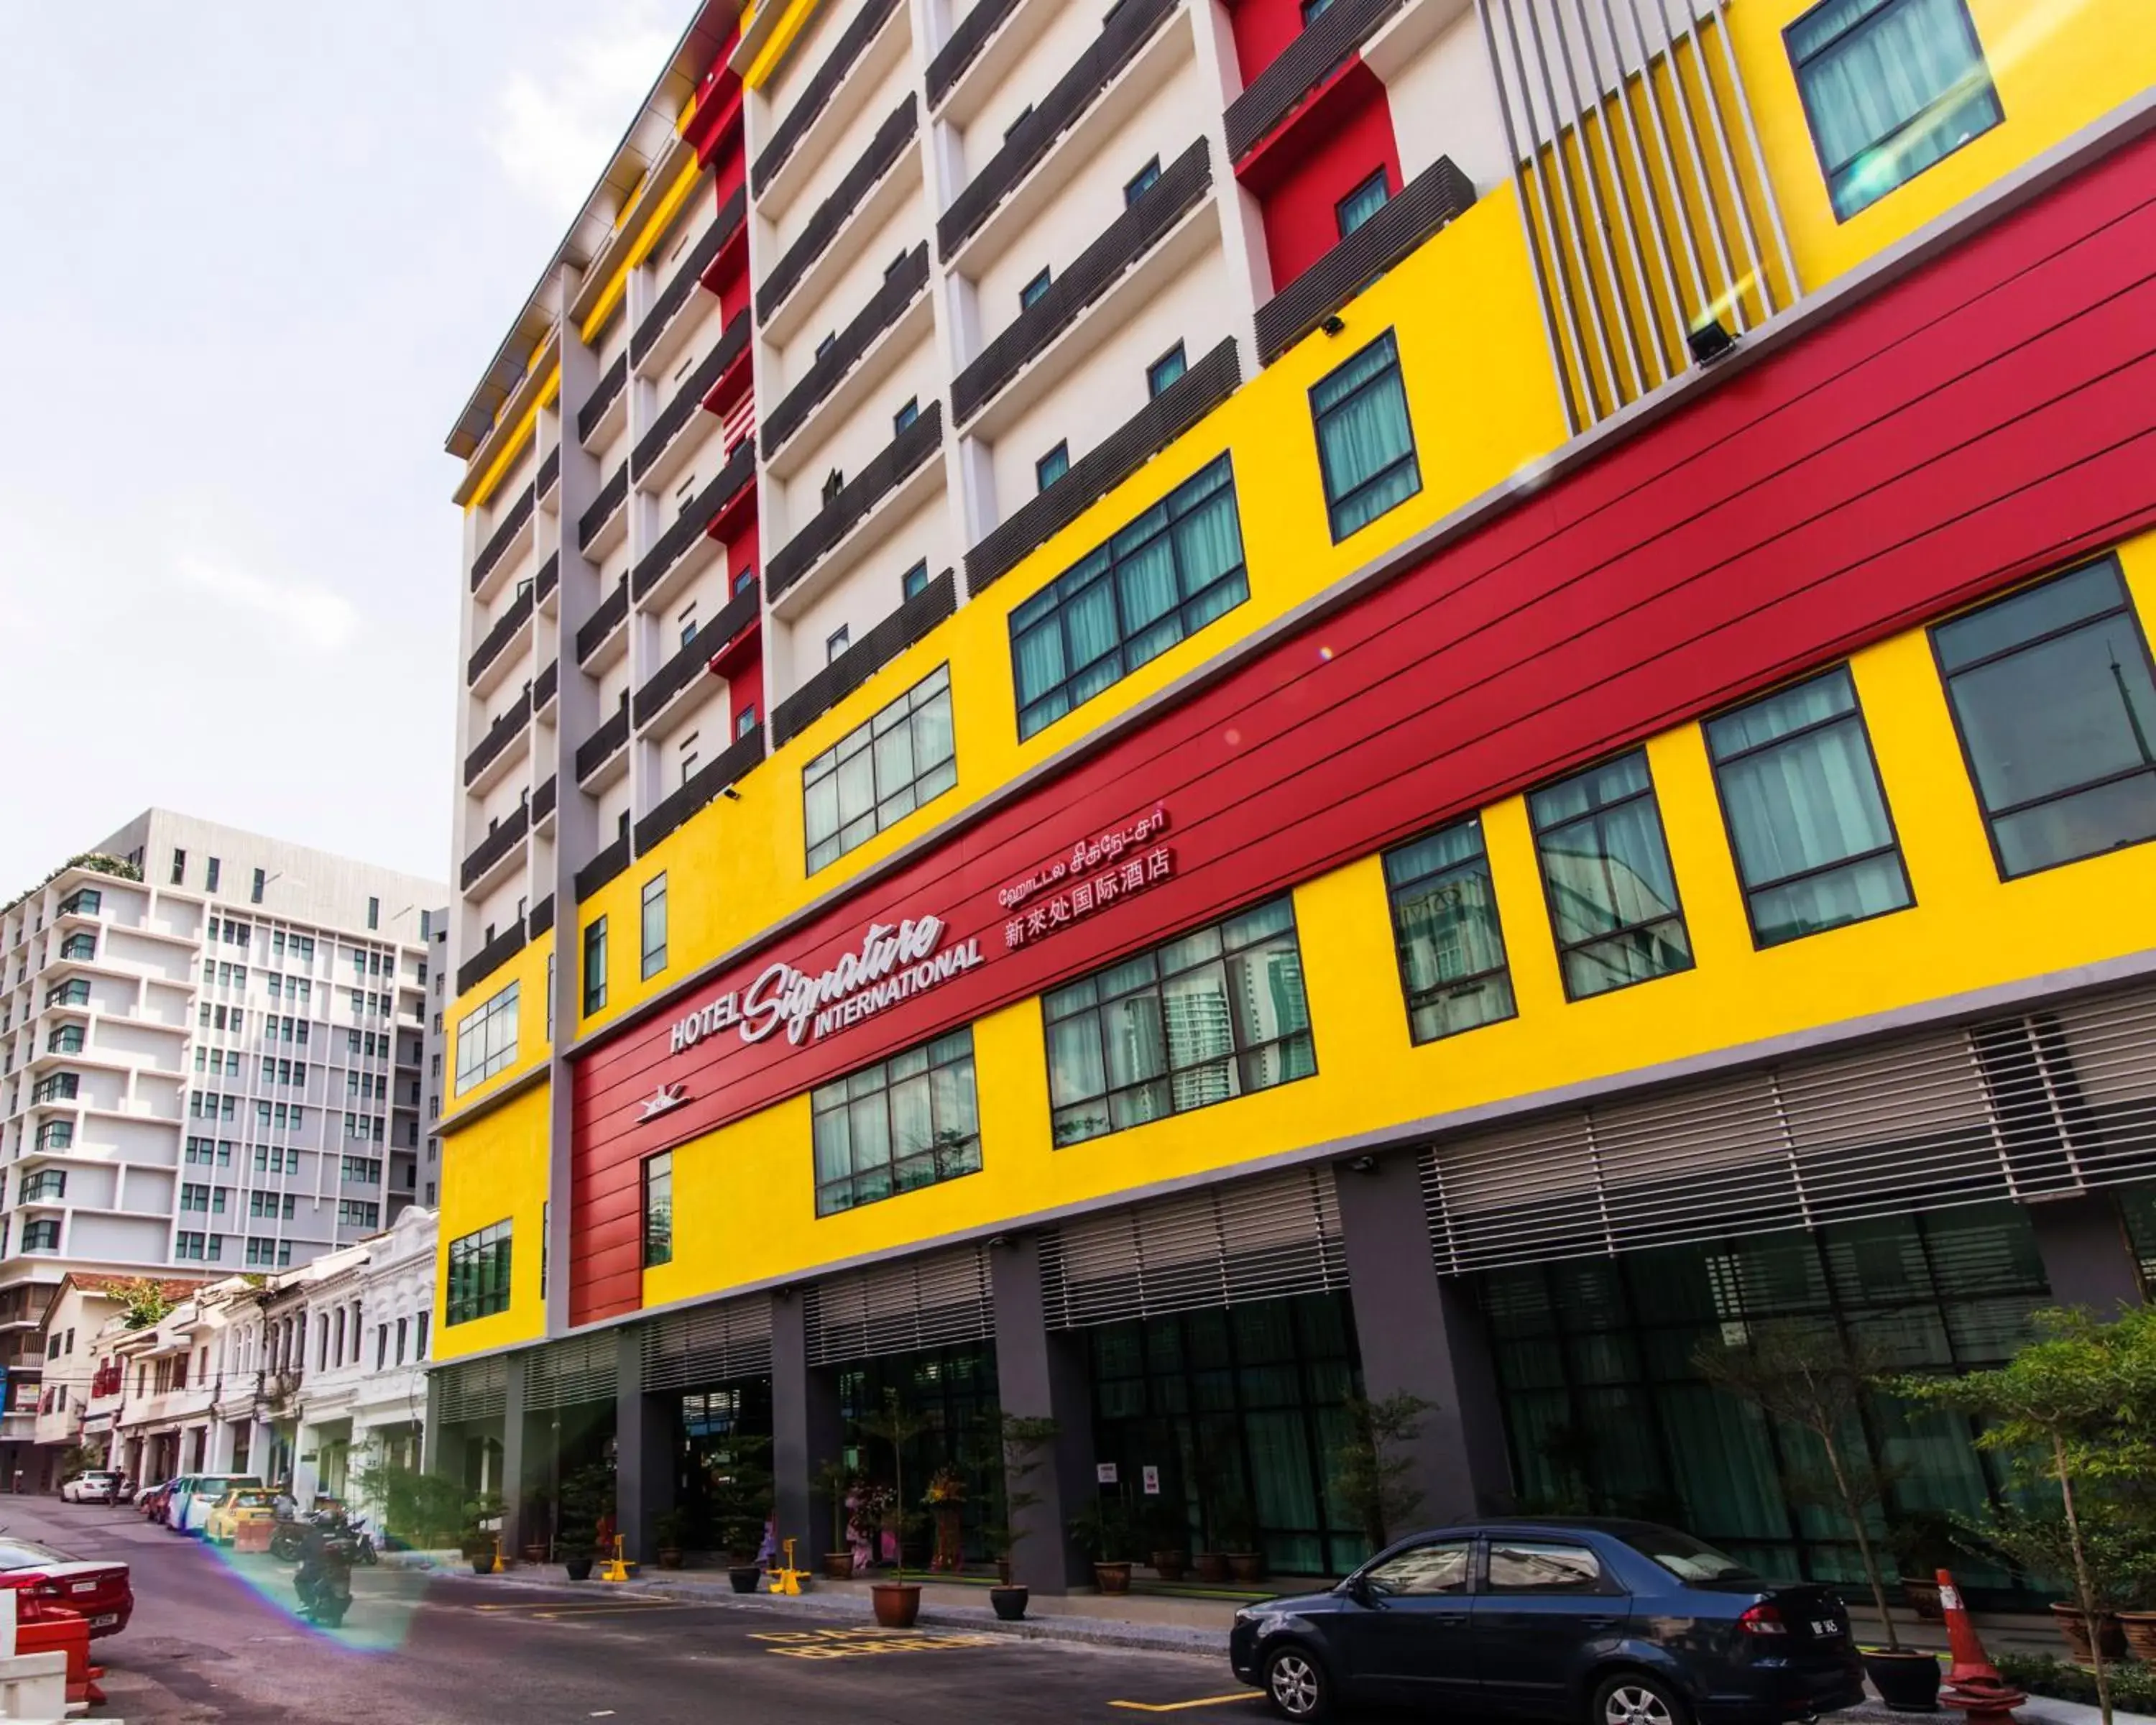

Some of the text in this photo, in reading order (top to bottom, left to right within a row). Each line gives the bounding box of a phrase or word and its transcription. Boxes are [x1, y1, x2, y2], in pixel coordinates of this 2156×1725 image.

[669, 914, 946, 1054] HOTEL Signature
[813, 938, 985, 1040] INTERNATIONAL
